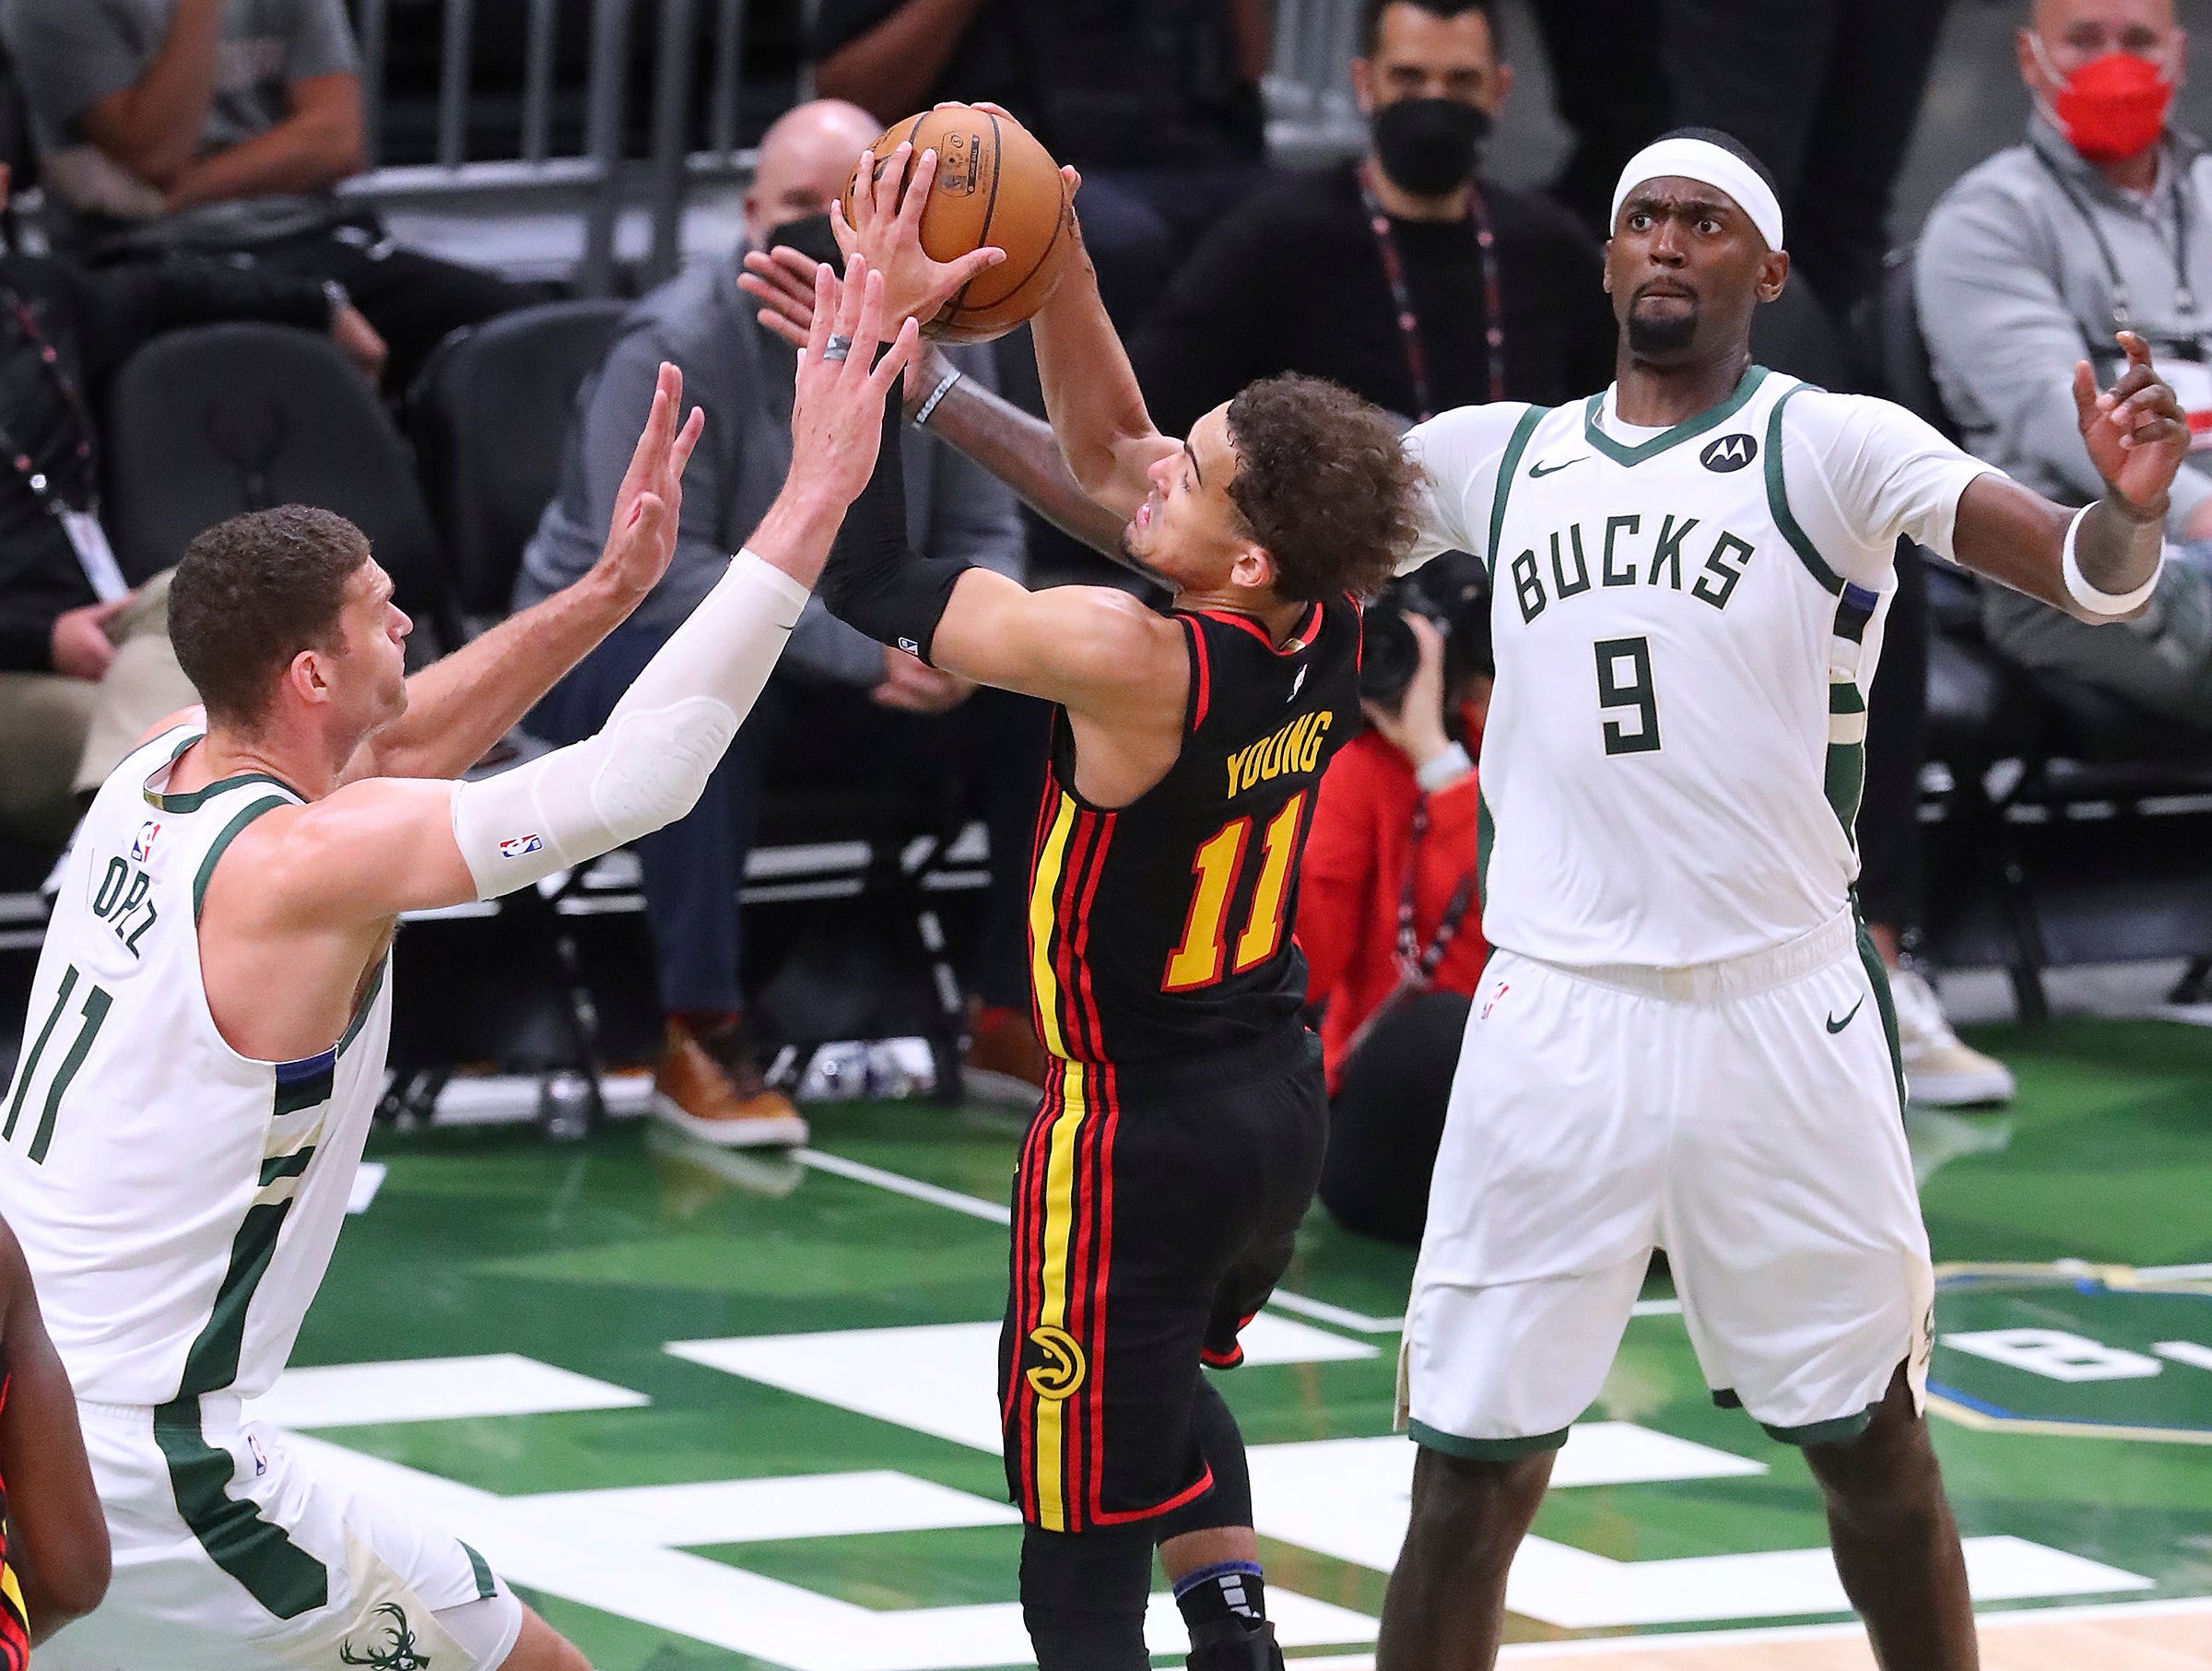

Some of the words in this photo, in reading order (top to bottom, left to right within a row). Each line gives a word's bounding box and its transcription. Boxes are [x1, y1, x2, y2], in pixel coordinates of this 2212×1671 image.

[1511, 513, 1756, 626] BUCKS
[1593, 636, 1662, 756] 9
[1227, 711, 1334, 800] YOUNG
[88, 848, 159, 960] OPZ
[1161, 788, 1308, 993] 11
[1, 962, 114, 1166] 11
